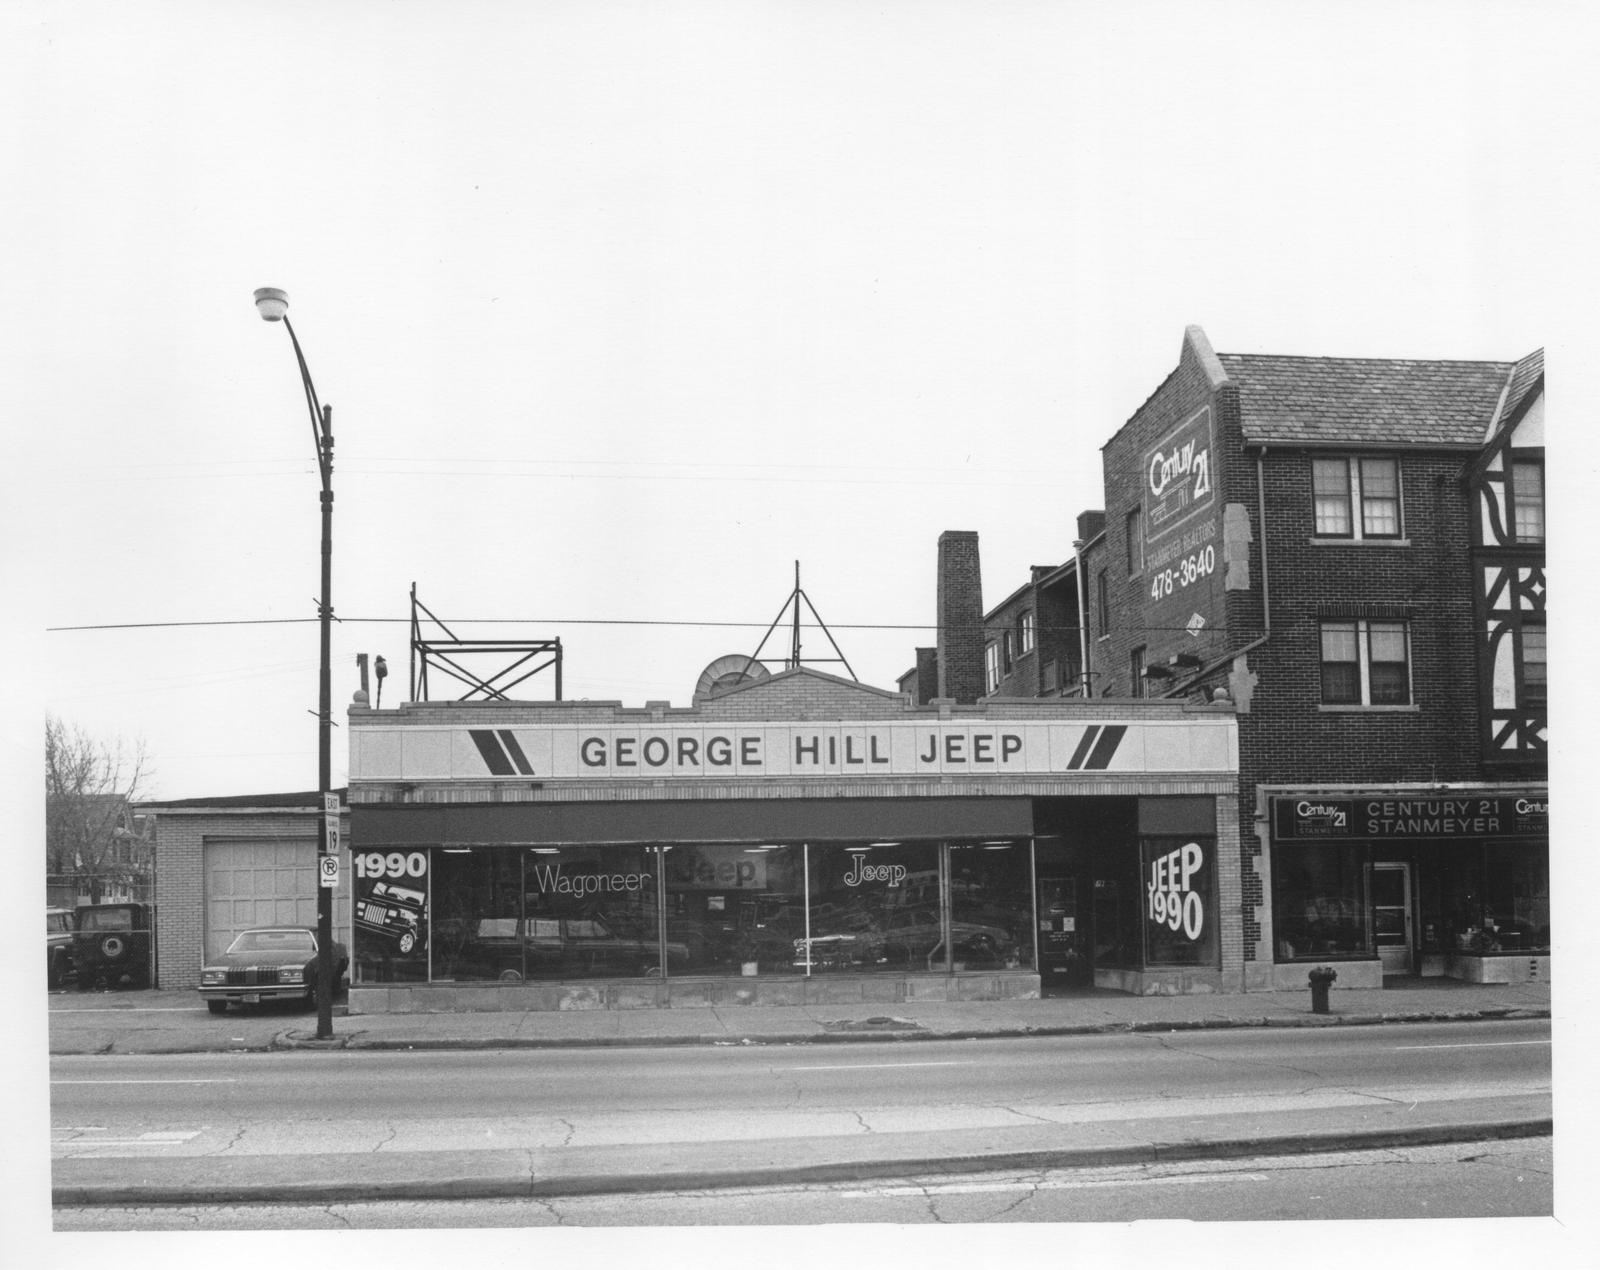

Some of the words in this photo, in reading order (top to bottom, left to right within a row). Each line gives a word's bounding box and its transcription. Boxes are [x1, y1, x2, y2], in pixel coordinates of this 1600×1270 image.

[1149, 438, 1195, 496] Century
[1193, 449, 1210, 500] 21
[1151, 544, 1214, 601] 478-3640
[581, 736, 762, 767] GEORGE
[795, 735, 889, 765] HILL
[920, 733, 1022, 763] JEEP
[1296, 801, 1338, 818] Century
[1334, 811, 1346, 827] 21
[1367, 801, 1470, 816] CENTURY
[1479, 800, 1499, 814] 21
[329, 831, 337, 849] 19
[1367, 818, 1500, 833] STANMEYER
[354, 852, 427, 878] 1990
[535, 864, 652, 898] Wagoneer
[844, 854, 907, 887] Jeep
[1147, 842, 1203, 892] JEEP
[1148, 890, 1203, 940] 1990
